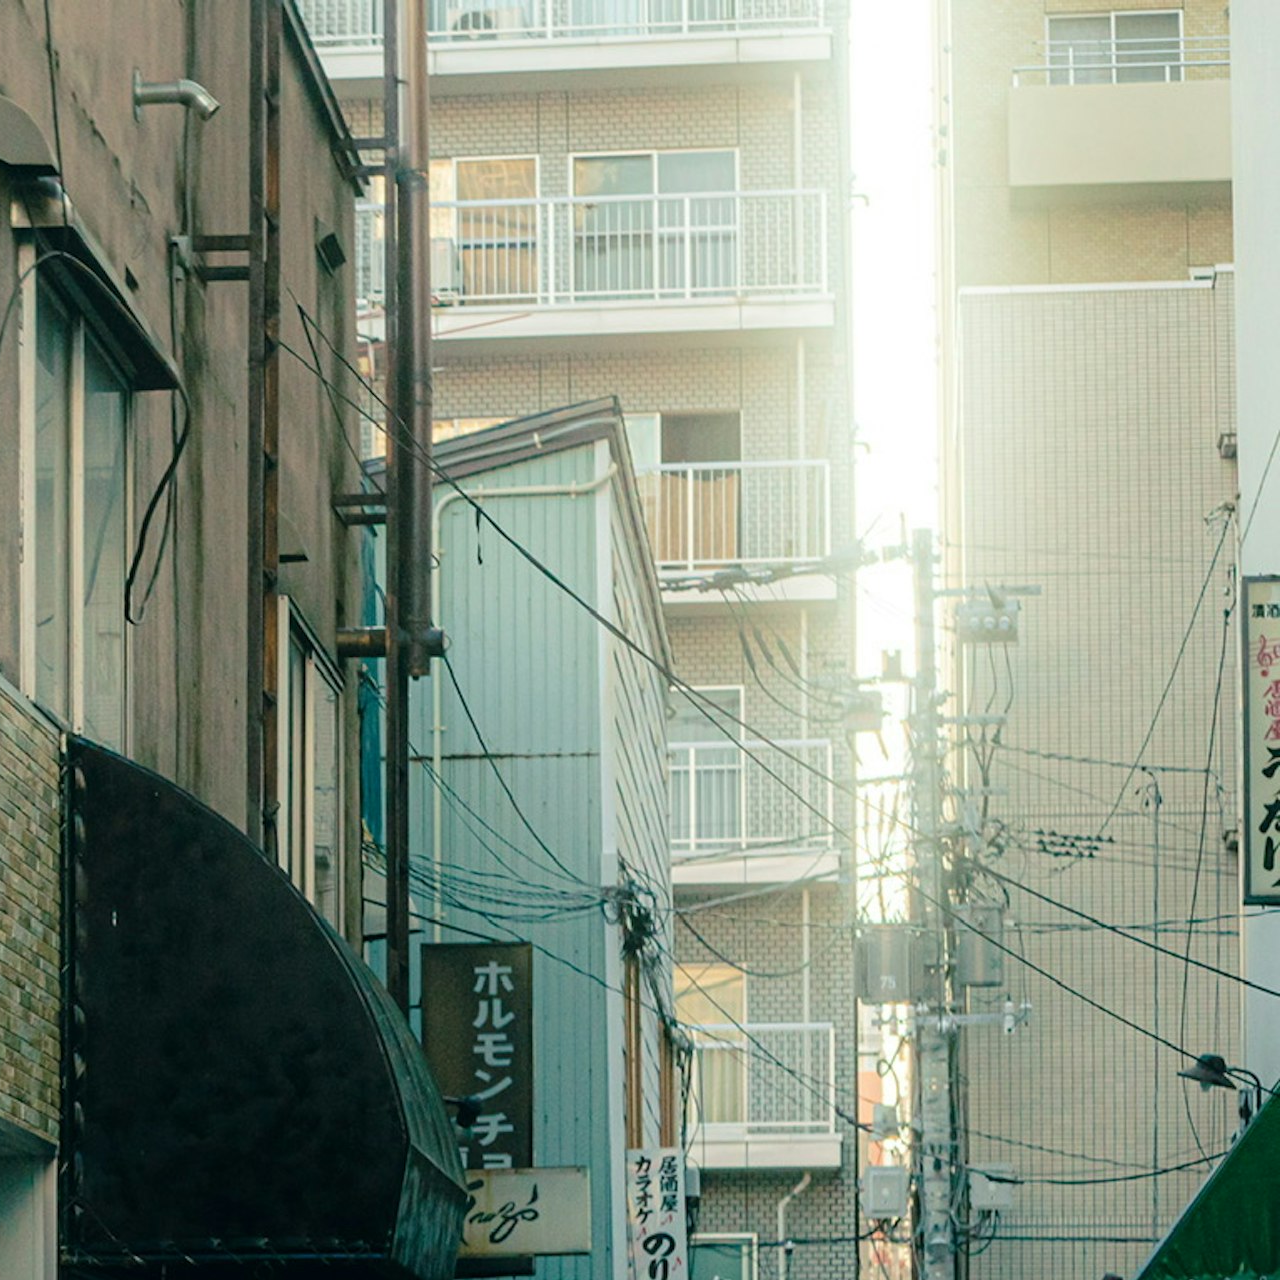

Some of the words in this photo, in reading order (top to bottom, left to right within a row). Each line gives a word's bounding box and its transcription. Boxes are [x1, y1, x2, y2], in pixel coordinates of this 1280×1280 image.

[635, 1156, 652, 1224] カラオケ
[659, 1156, 678, 1212] 居酒屋
